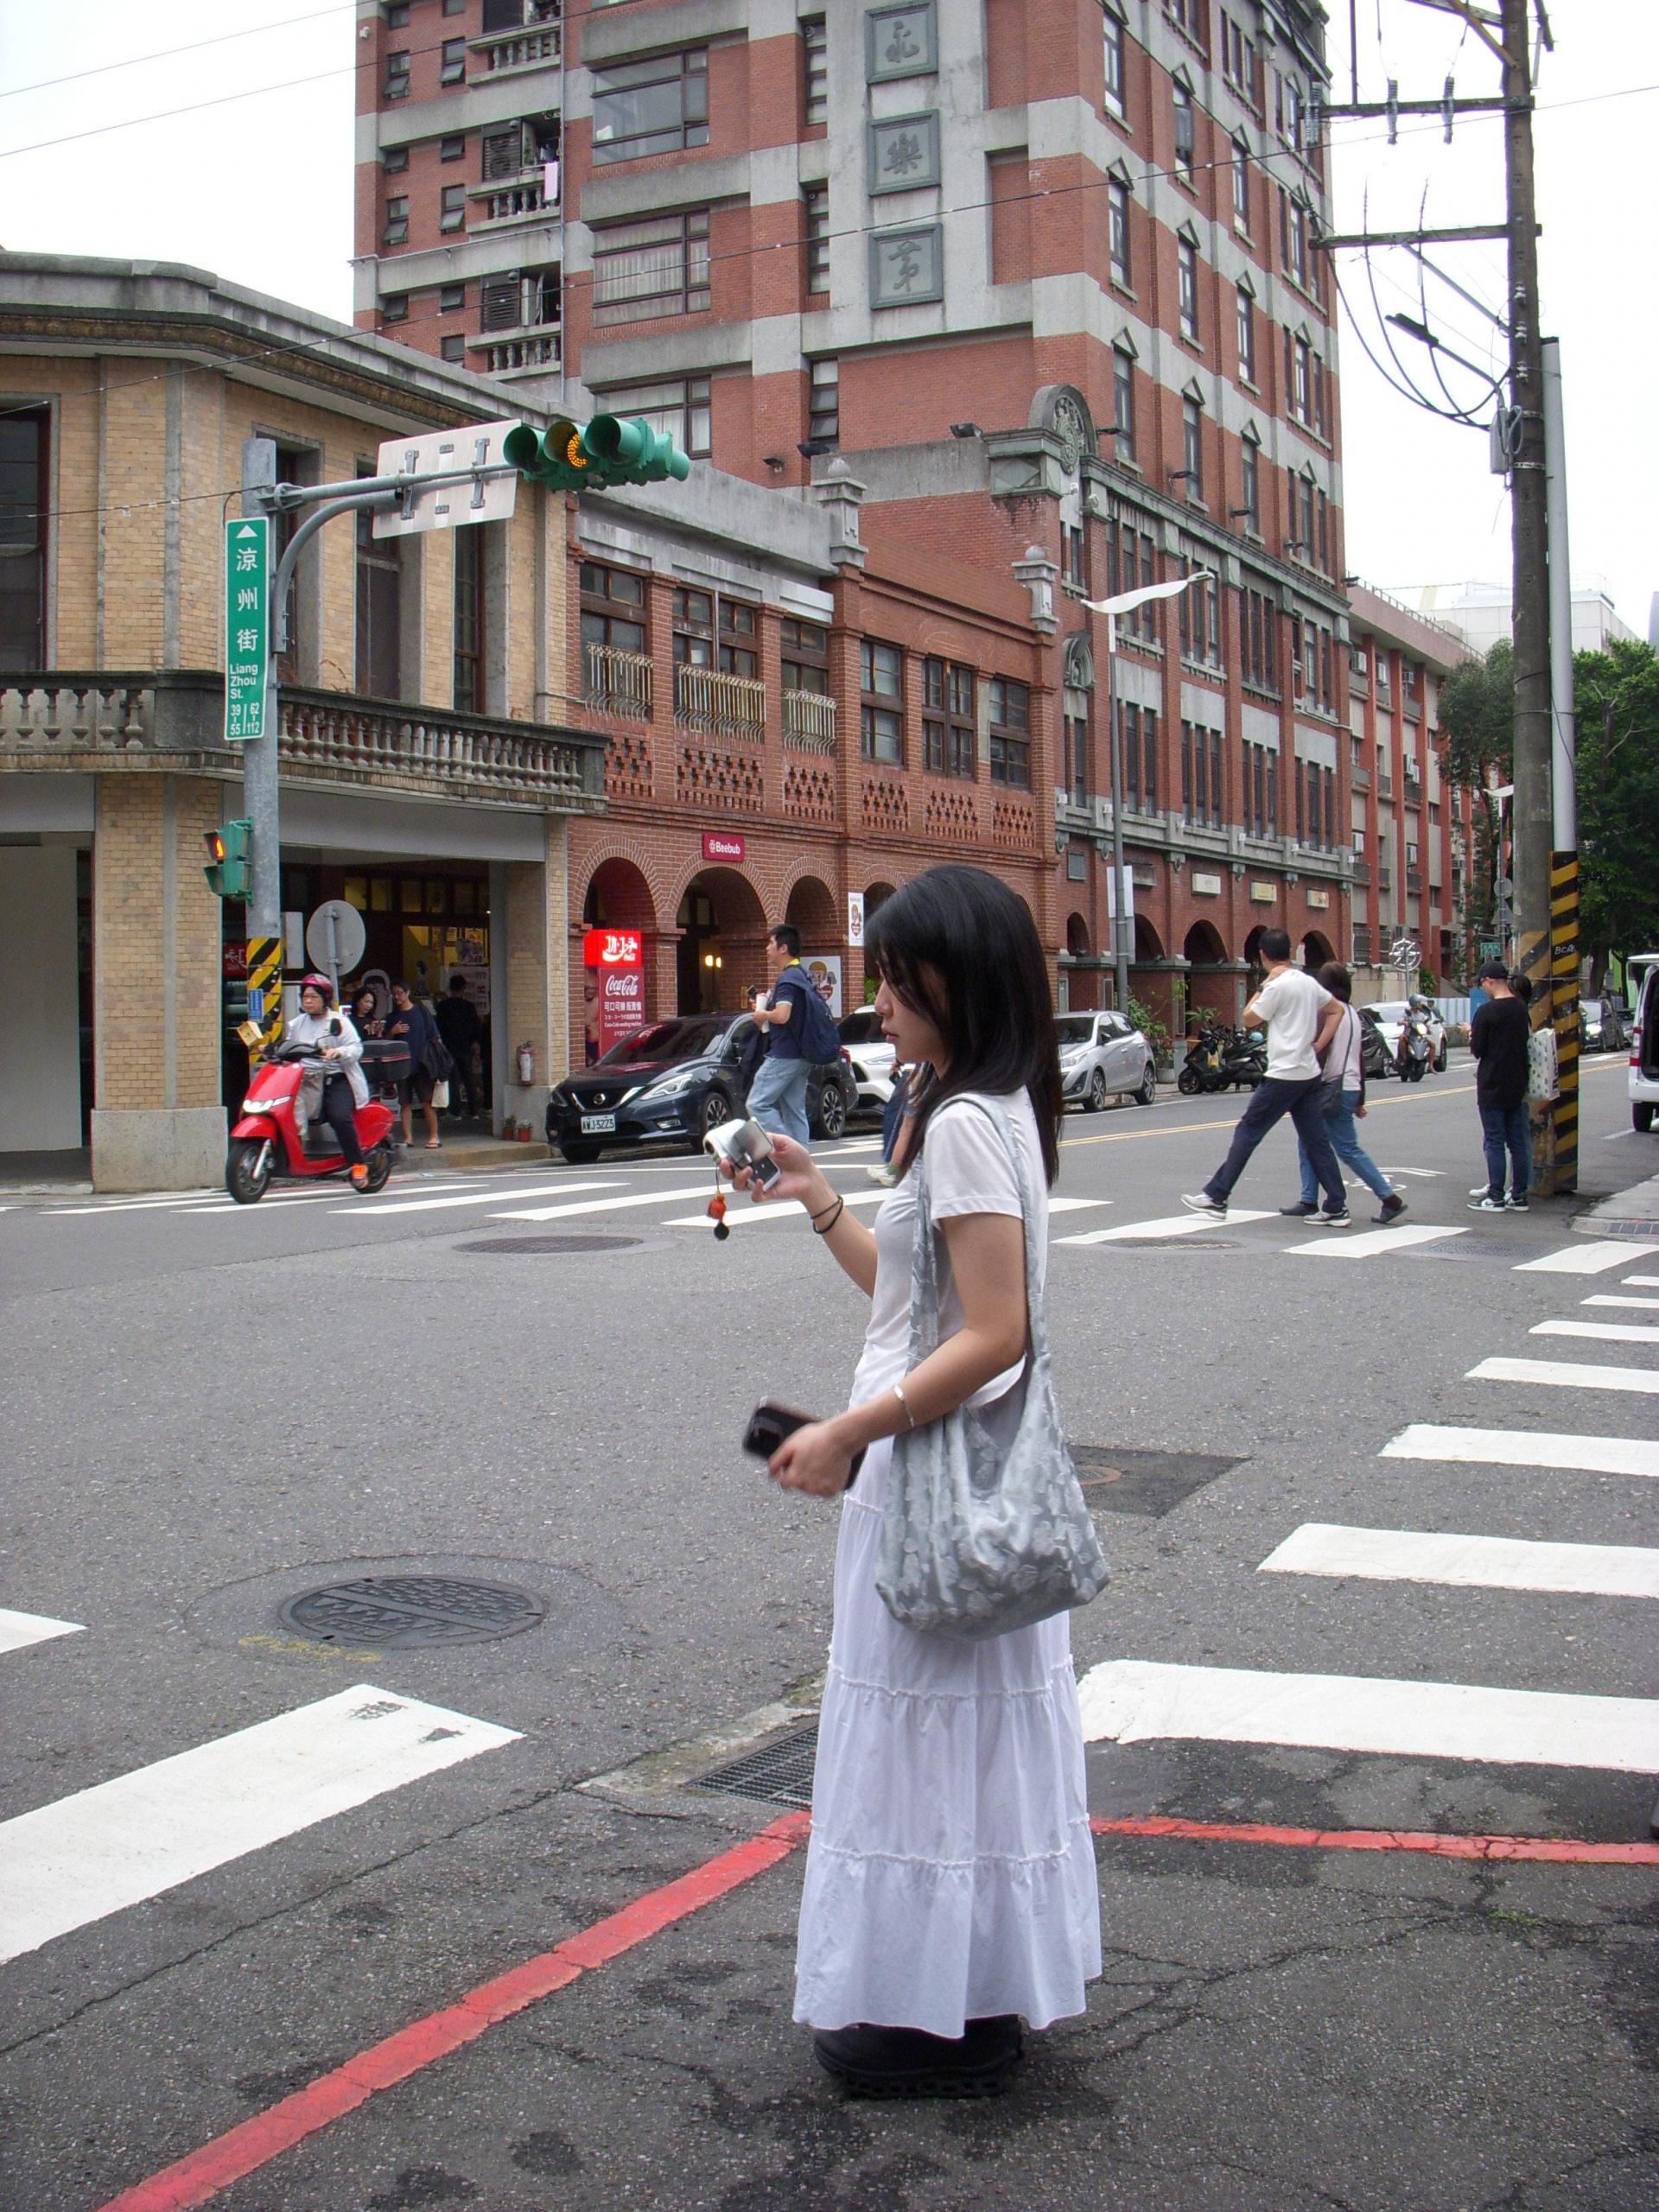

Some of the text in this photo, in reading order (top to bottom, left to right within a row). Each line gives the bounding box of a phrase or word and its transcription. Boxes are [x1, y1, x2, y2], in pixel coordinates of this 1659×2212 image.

[236, 547, 258, 652] 涼州街
[229, 664, 258, 675] Liang
[230, 676, 257, 687] Zhou
[230, 689, 244, 699] St.
[231, 704, 241, 716] 39
[250, 702, 260, 715] 62
[229, 723, 241, 735] 55
[247, 721, 260, 734] 112
